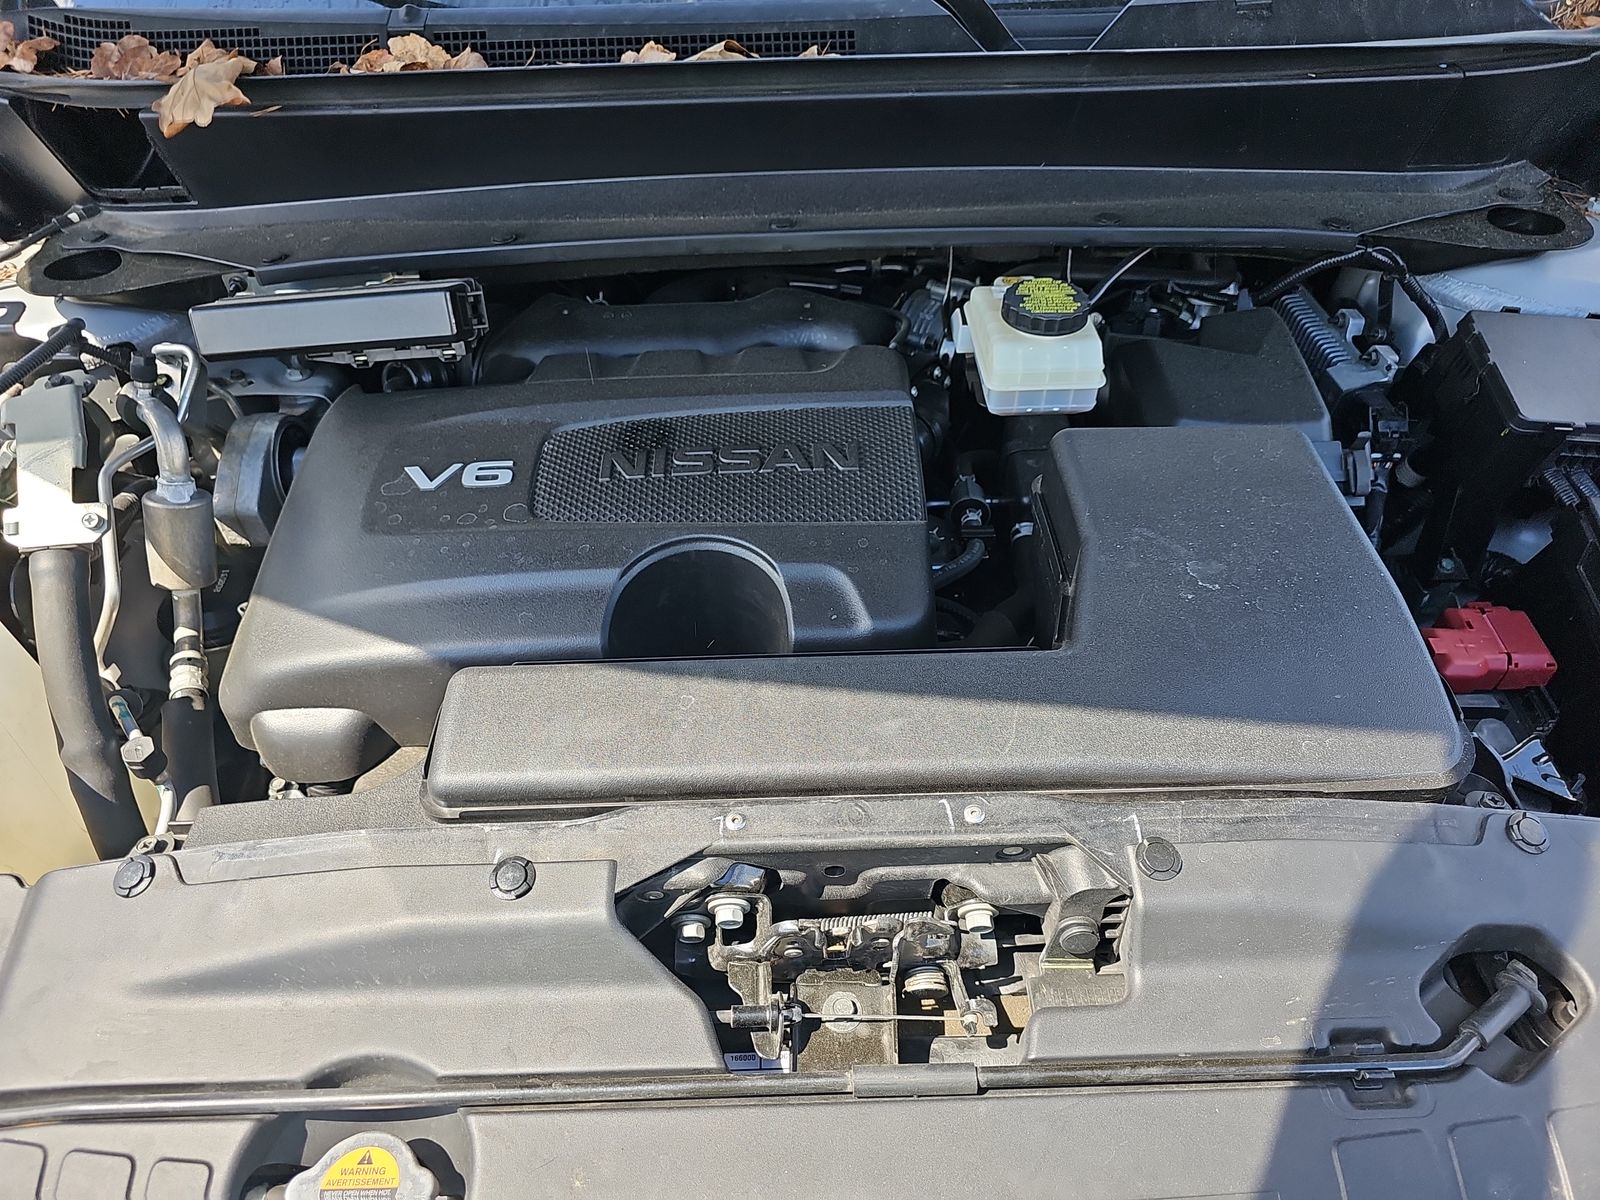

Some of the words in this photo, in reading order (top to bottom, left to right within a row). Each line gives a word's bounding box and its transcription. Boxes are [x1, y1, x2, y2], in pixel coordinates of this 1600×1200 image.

[599, 442, 860, 482] NISSAN
[404, 460, 513, 491] V6
[340, 1167, 386, 1176] WARNING
[325, 1177, 396, 1187] AVERTISSEMENT
